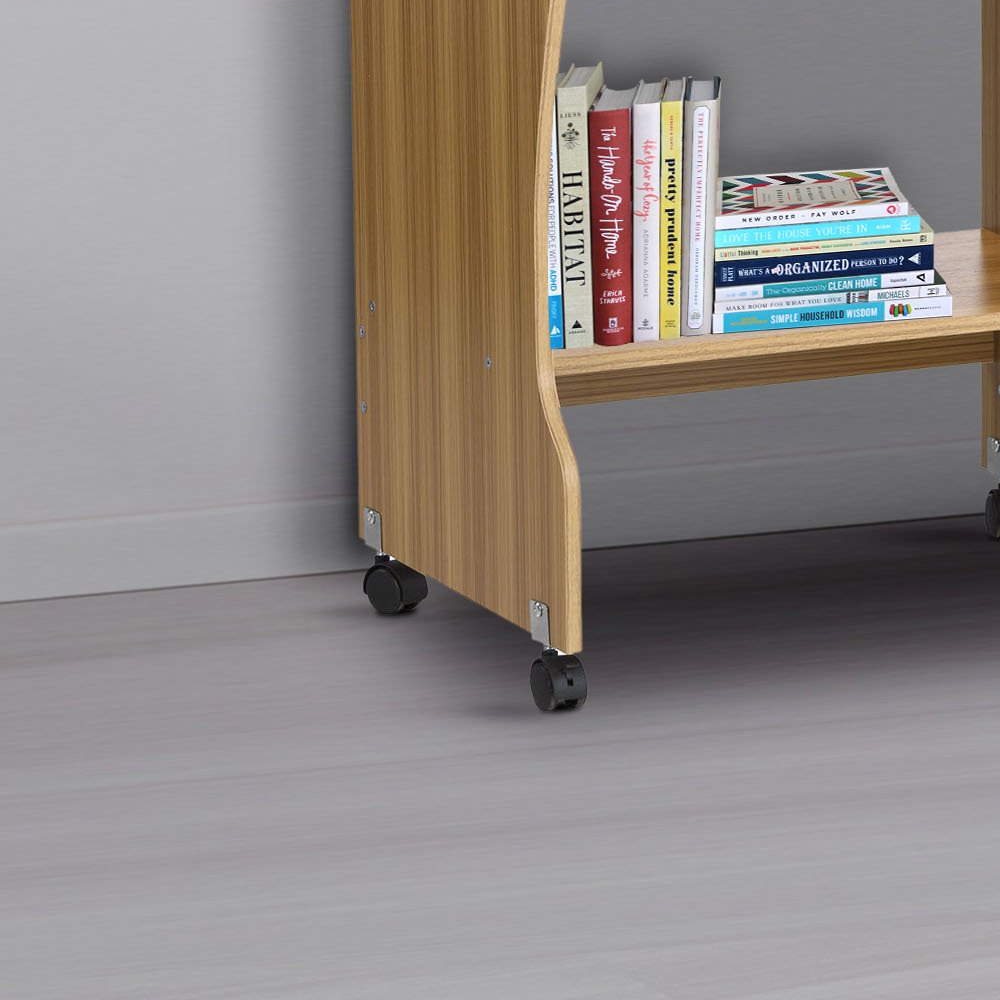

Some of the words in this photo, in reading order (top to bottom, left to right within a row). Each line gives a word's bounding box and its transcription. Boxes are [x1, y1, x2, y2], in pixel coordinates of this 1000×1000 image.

[600, 126, 617, 142] The
[596, 146, 622, 216] Hands-On
[664, 158, 677, 202] pretty
[765, 214, 796, 222] ORDER
[548, 220, 557, 248] PEOPLE
[562, 171, 586, 287] HABITAT
[664, 208, 678, 265] prudent
[723, 231, 750, 243] LOVE
[755, 230, 773, 241] THE
[777, 227, 812, 239] HOUSE
[815, 224, 853, 237] YOU'RE
[856, 224, 868, 233] IN
[599, 219, 624, 260] Home
[549, 248, 557, 269] WITH
[738, 249, 759, 257] Thinking
[738, 267, 763, 277] WHAT'S
[776, 258, 850, 276] ORGANIZED
[850, 258, 877, 268] PERSON
[879, 258, 887, 266] TO
[550, 269, 558, 292] ADHD
[666, 269, 678, 306] home
[782, 284, 828, 295] Organically
[827, 279, 853, 291] CLEAN
[855, 277, 878, 289] HOME
[600, 296, 626, 305] STRAUSS
[602, 289, 623, 298] ERICA
[877, 289, 910, 300] MICHAELS
[726, 304, 746, 312] MAKE
[770, 312, 799, 325] SIMPLE
[799, 309, 845, 322] HOUSEHOLD
[846, 307, 878, 319] WISDOM
